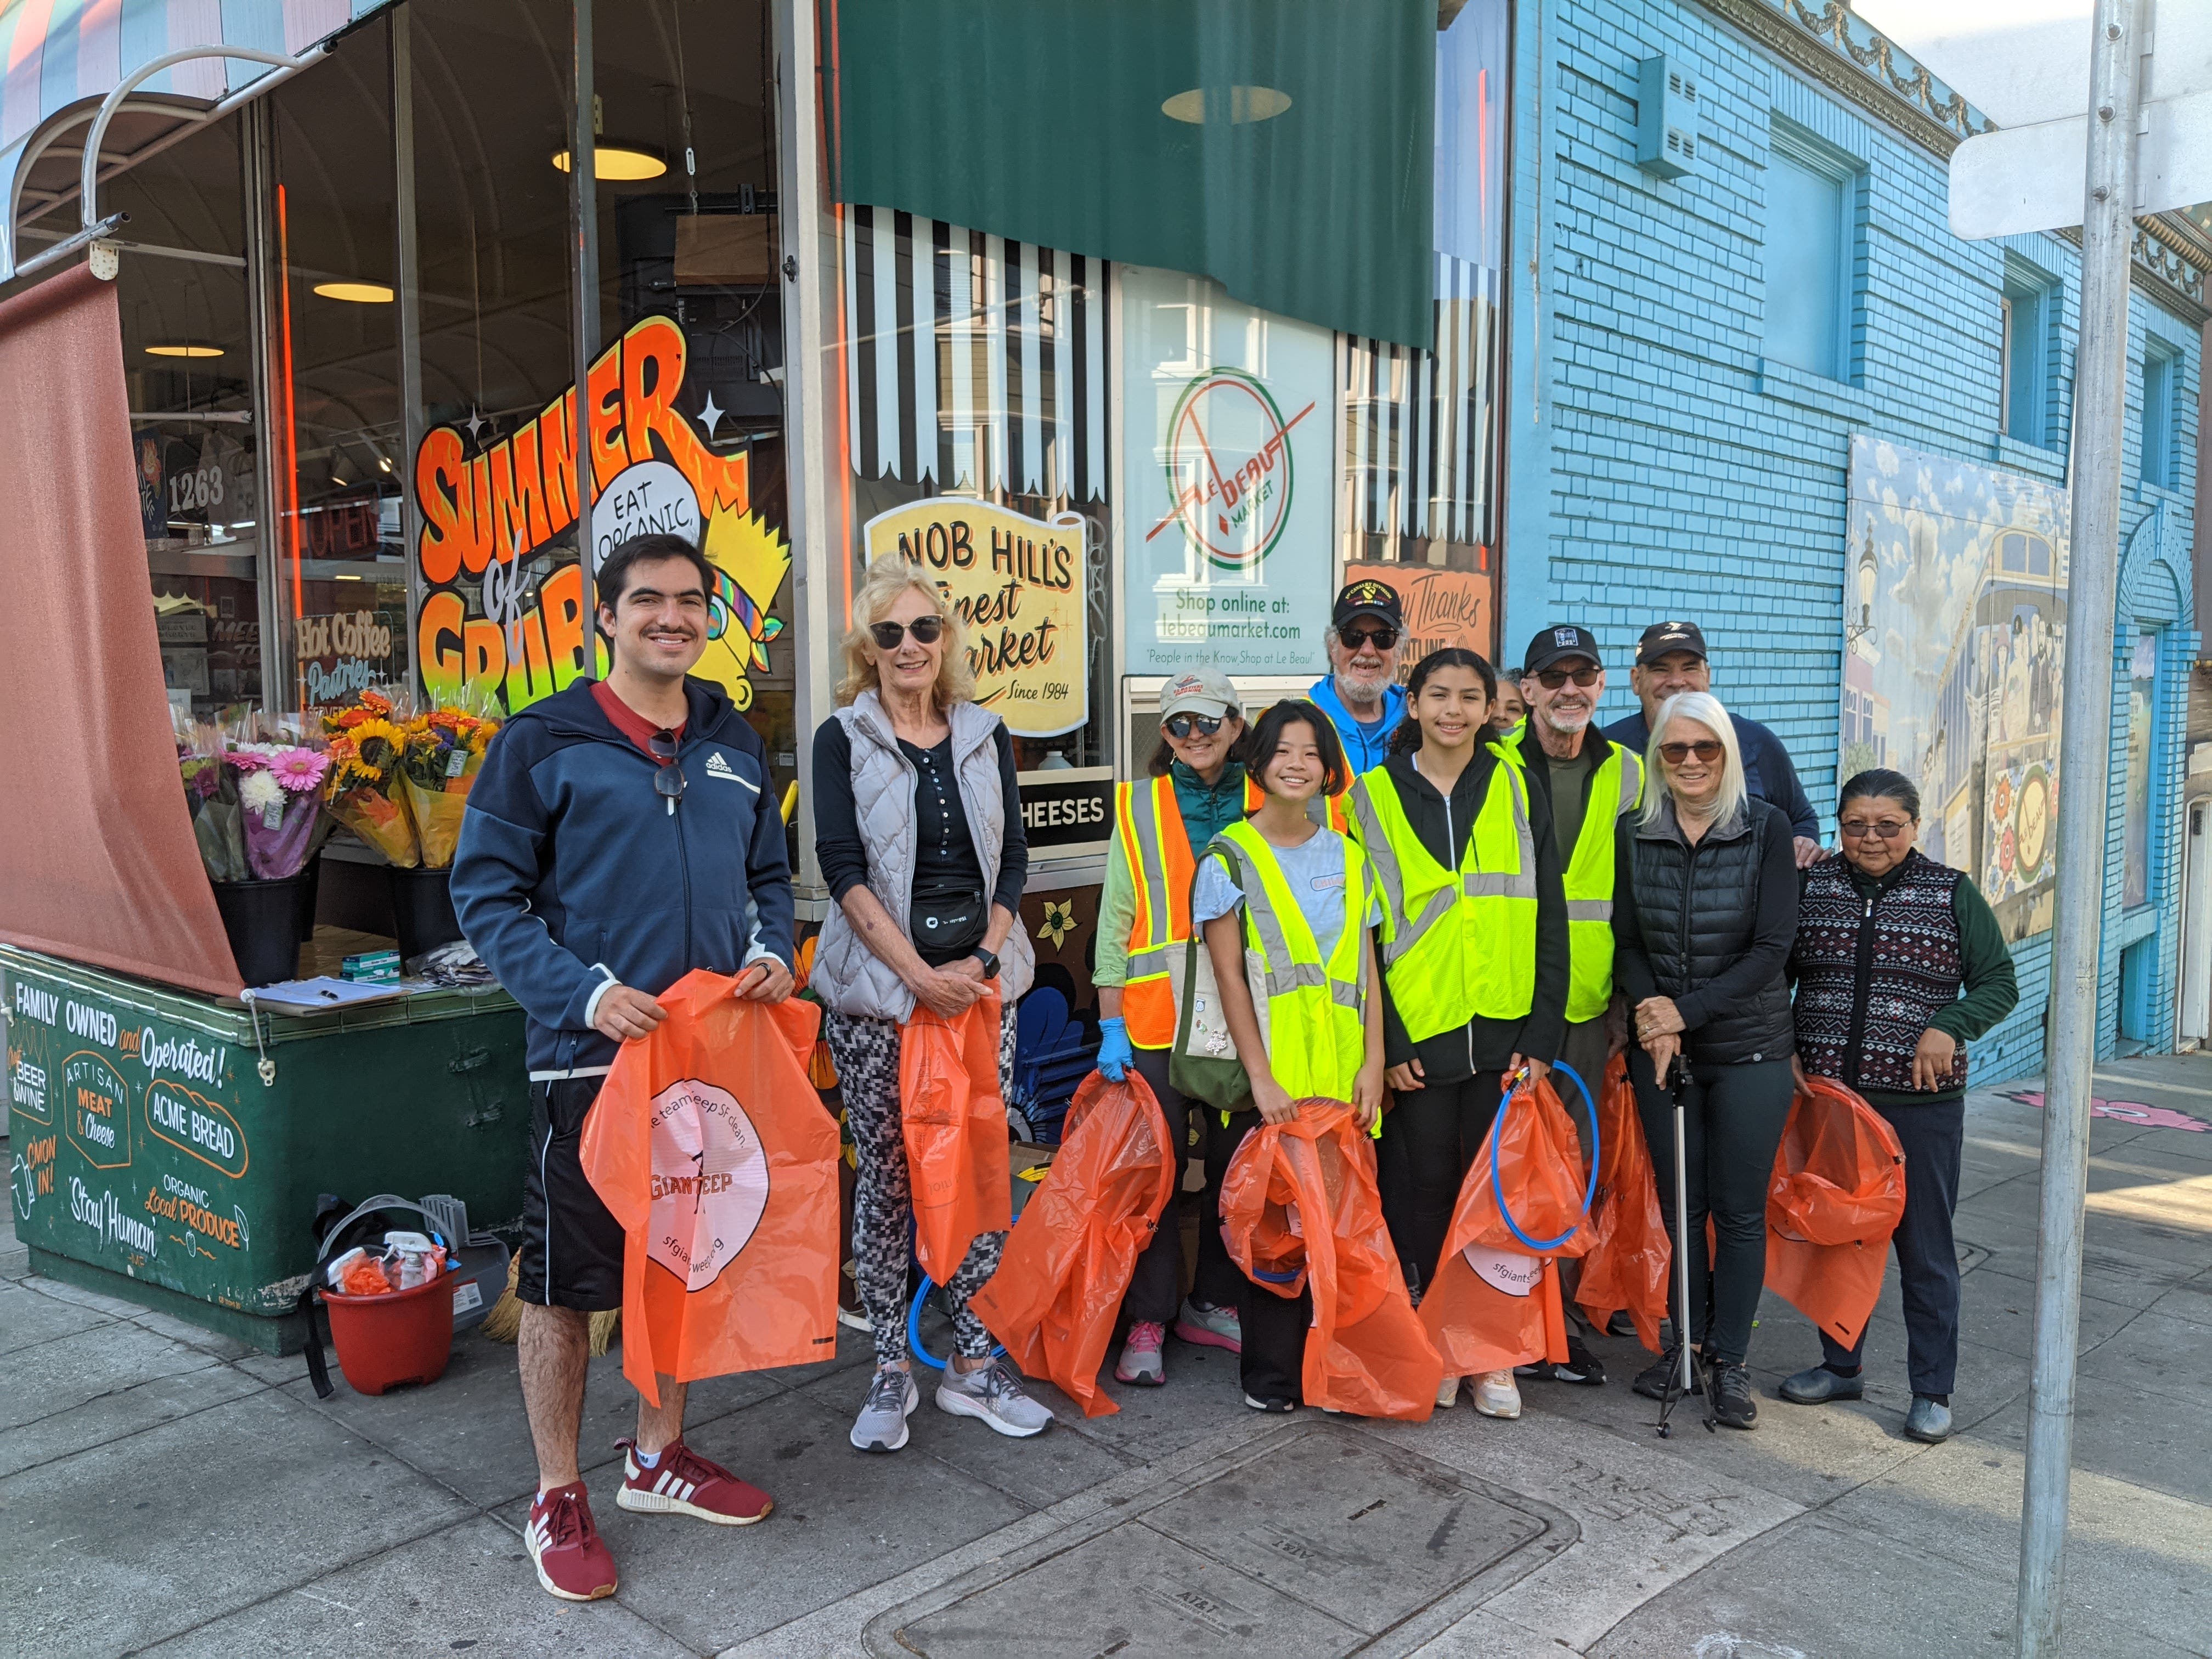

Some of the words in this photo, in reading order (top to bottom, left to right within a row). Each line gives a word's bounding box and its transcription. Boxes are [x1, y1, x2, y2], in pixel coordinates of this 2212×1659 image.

[414, 312, 749, 585] SUMMER
[170, 465, 224, 512] 1263
[614, 481, 652, 520] EAT
[1231, 479, 1273, 528] MARKET
[898, 521, 978, 571] NOB
[991, 526, 1074, 594] HILL'S
[483, 528, 531, 667] of
[1176, 587, 1216, 616] Shop
[1222, 590, 1266, 613] online
[1272, 597, 1290, 613] at:
[1350, 582, 1372, 594] CAVALRY
[1373, 583, 1392, 599] DIVISION
[1412, 573, 1480, 630] Thanks
[295, 617, 331, 659] Hot
[332, 609, 391, 659] Coffee
[1163, 613, 1300, 639] lebeaumarket.com
[964, 617, 1059, 682] arket
[1184, 652, 1192, 663] in
[1196, 650, 1210, 663] the
[1264, 654, 1273, 664] at
[1277, 651, 1286, 664] Le
[308, 655, 376, 707] Pastries
[1006, 679, 1038, 700] Since
[1042, 682, 1069, 700] 1984
[706, 763, 732, 773] adidas
[1020, 797, 1104, 828] HEESES
[15, 982, 59, 1028] FAMILY
[66, 1000, 117, 1047] OWNED
[119, 1024, 142, 1053] and
[142, 1026, 226, 1089] Operated!
[17, 1060, 46, 1091] BEER
[66, 1062, 123, 1105] ARTISAN
[77, 1087, 113, 1119] MEAT
[659, 1094, 693, 1119] team
[719, 1103, 731, 1117] SF
[729, 1116, 746, 1149] clean.
[77, 1110, 84, 1136] &
[85, 1113, 115, 1149] Cheese
[153, 1092, 187, 1136] ACME
[191, 1110, 235, 1159] BREAD
[27, 1134, 57, 1170] C'MON
[37, 1161, 54, 1197] IN!
[163, 1174, 210, 1209] ORGANIC
[145, 1187, 177, 1222] Local
[180, 1200, 240, 1248] PRODUCE
[1176, 1591, 1221, 1613] AT&T
